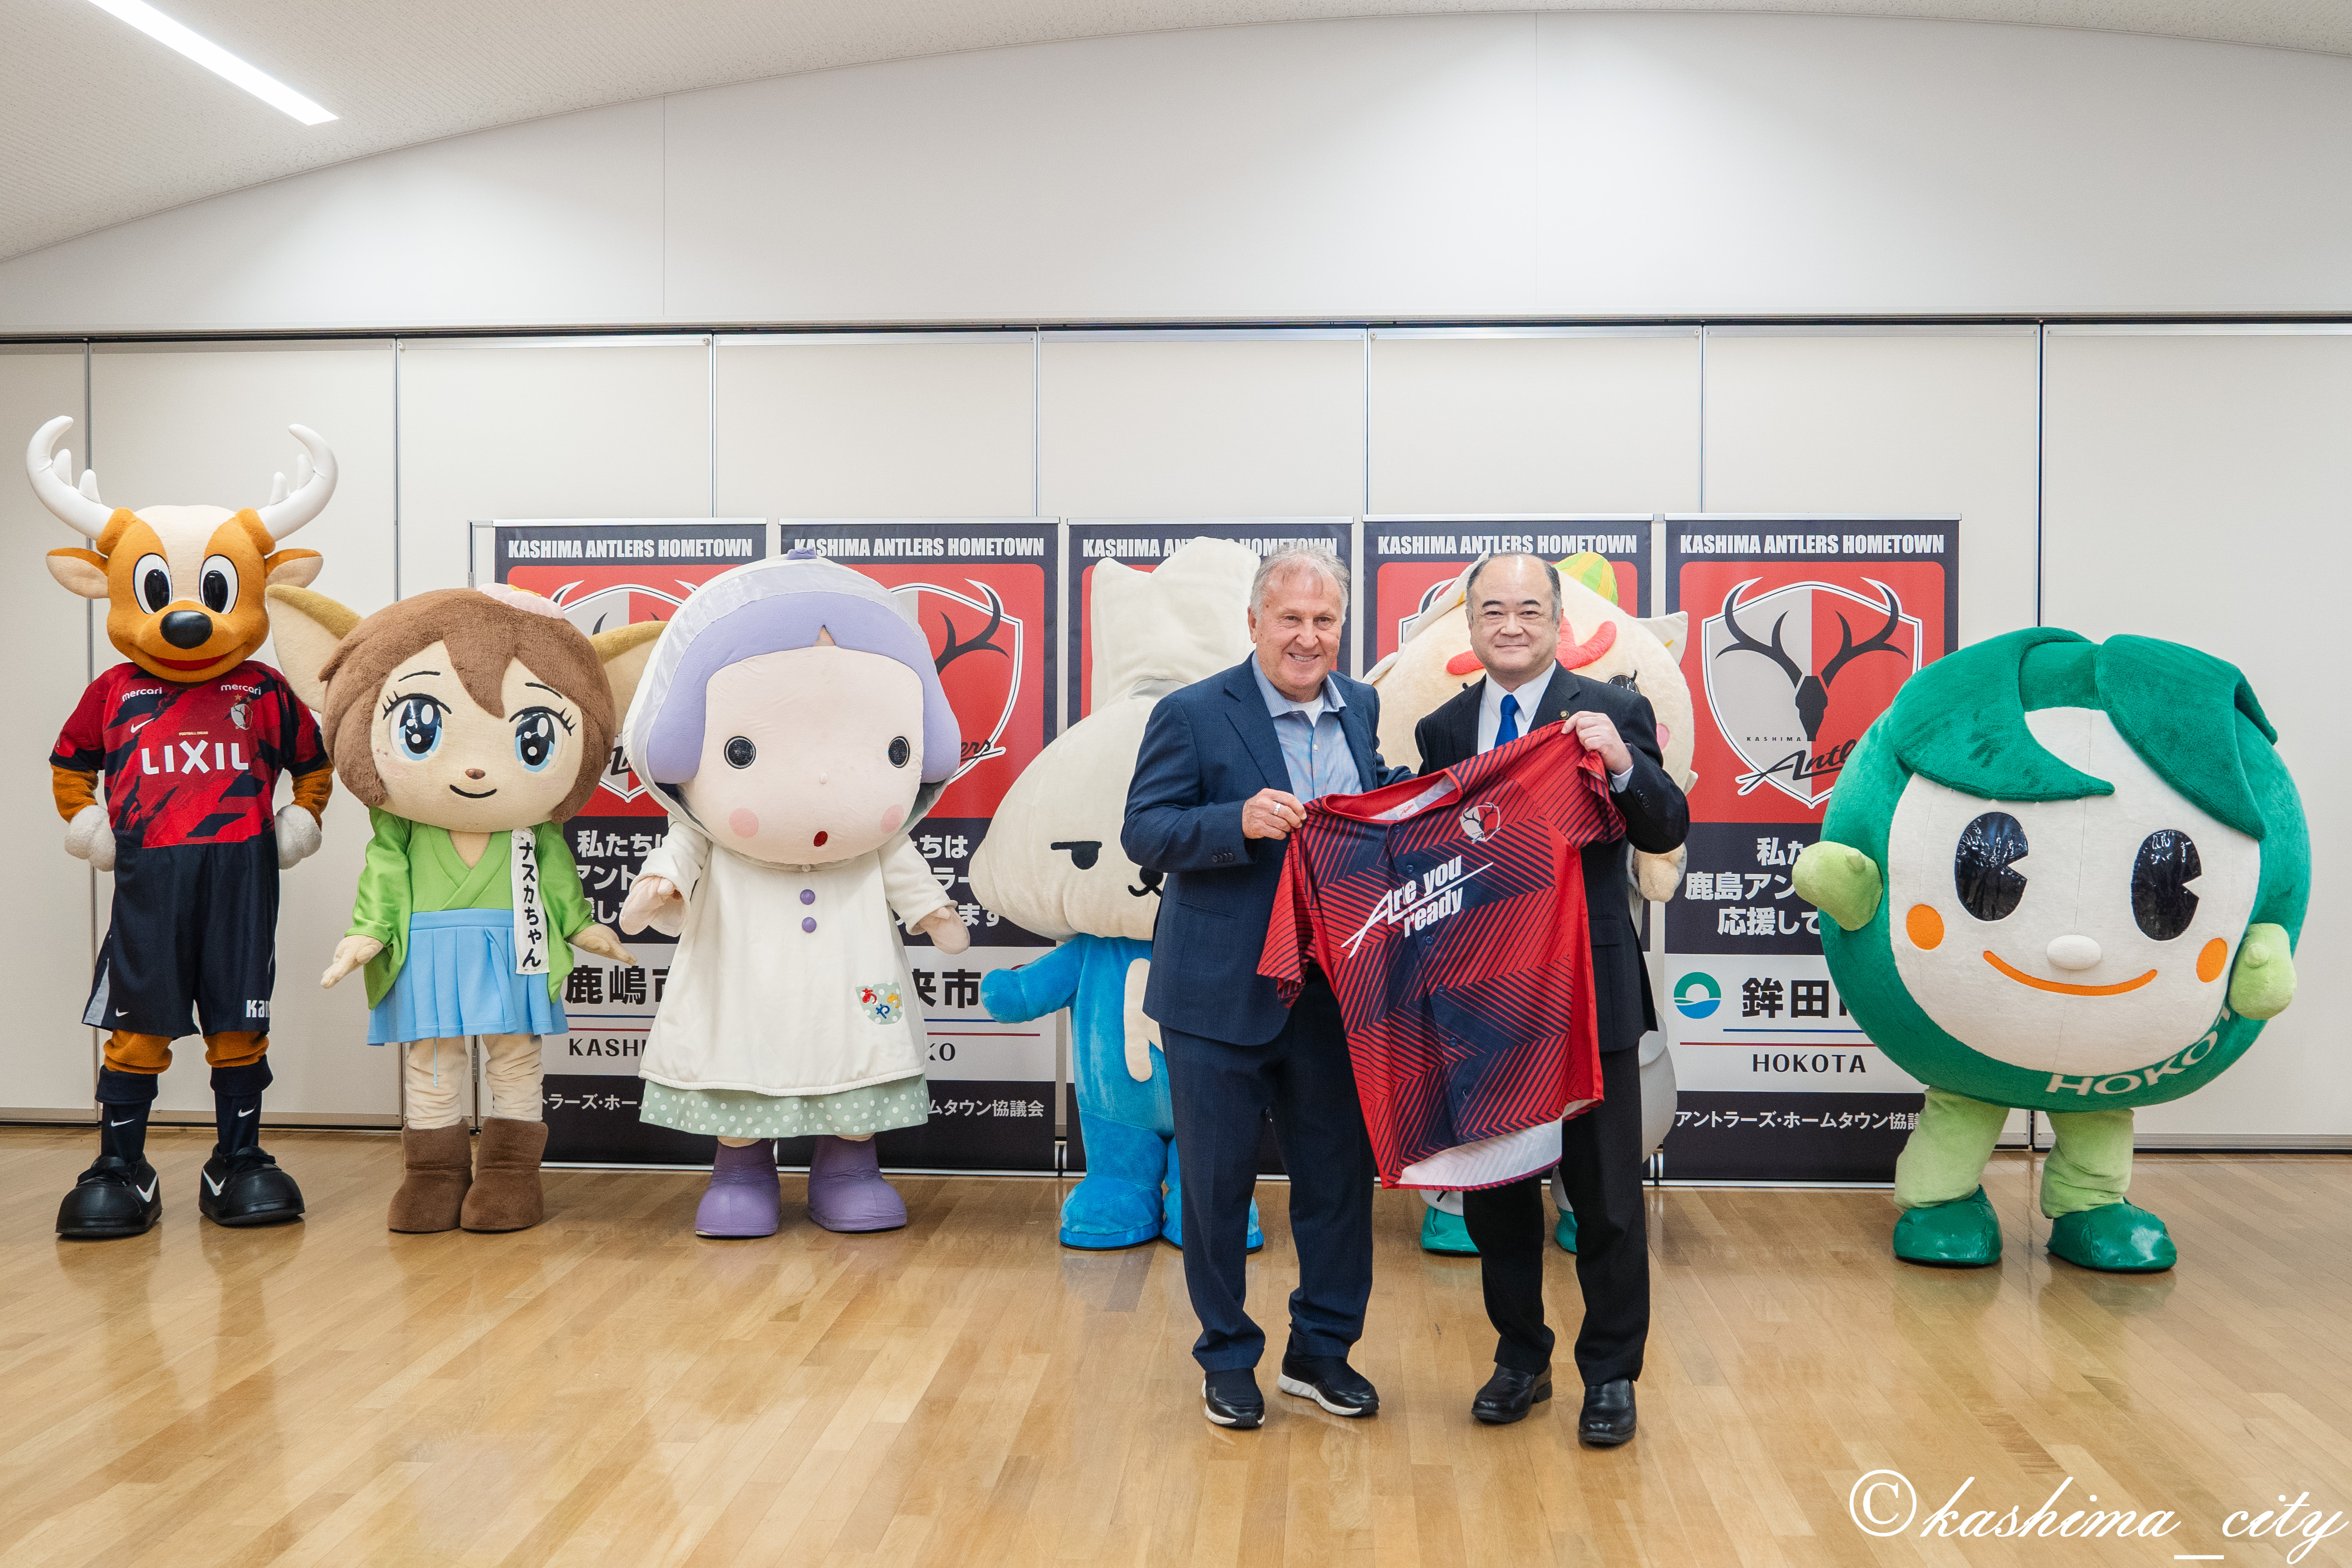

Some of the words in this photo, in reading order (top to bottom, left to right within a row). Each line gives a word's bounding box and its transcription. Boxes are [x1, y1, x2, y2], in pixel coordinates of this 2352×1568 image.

[508, 540, 583, 558] KASHIMA
[586, 540, 655, 558] ANTLERS
[658, 539, 752, 557] HOMETOWN
[794, 539, 871, 557] KASHIMA
[873, 538, 945, 556] ANTLERS
[948, 538, 1044, 556] HOMETOWN
[1082, 539, 1160, 557] KASHIMA
[1378, 536, 1457, 554] KASHIMA
[1460, 535, 1534, 554] ANTLERS
[1537, 535, 1637, 554] HOMETOWN
[1680, 535, 1761, 554] KASHIMA
[1764, 535, 1839, 553] ANTLERS
[1843, 534, 1944, 553] HOMETOWN
[122, 687, 162, 702] mercari
[220, 684, 262, 695] mercari
[141, 740, 249, 775] LIXIL
[912, 835, 968, 859] ちは
[1423, 855, 1461, 897] you
[519, 842, 542, 968] ナスカちゃん
[1404, 887, 1463, 938] ready
[1742, 977, 1847, 1019] 鉾田
[1753, 1054, 1867, 1073] HOKOTA
[542, 1093, 642, 1111] ラーズ・ホー
